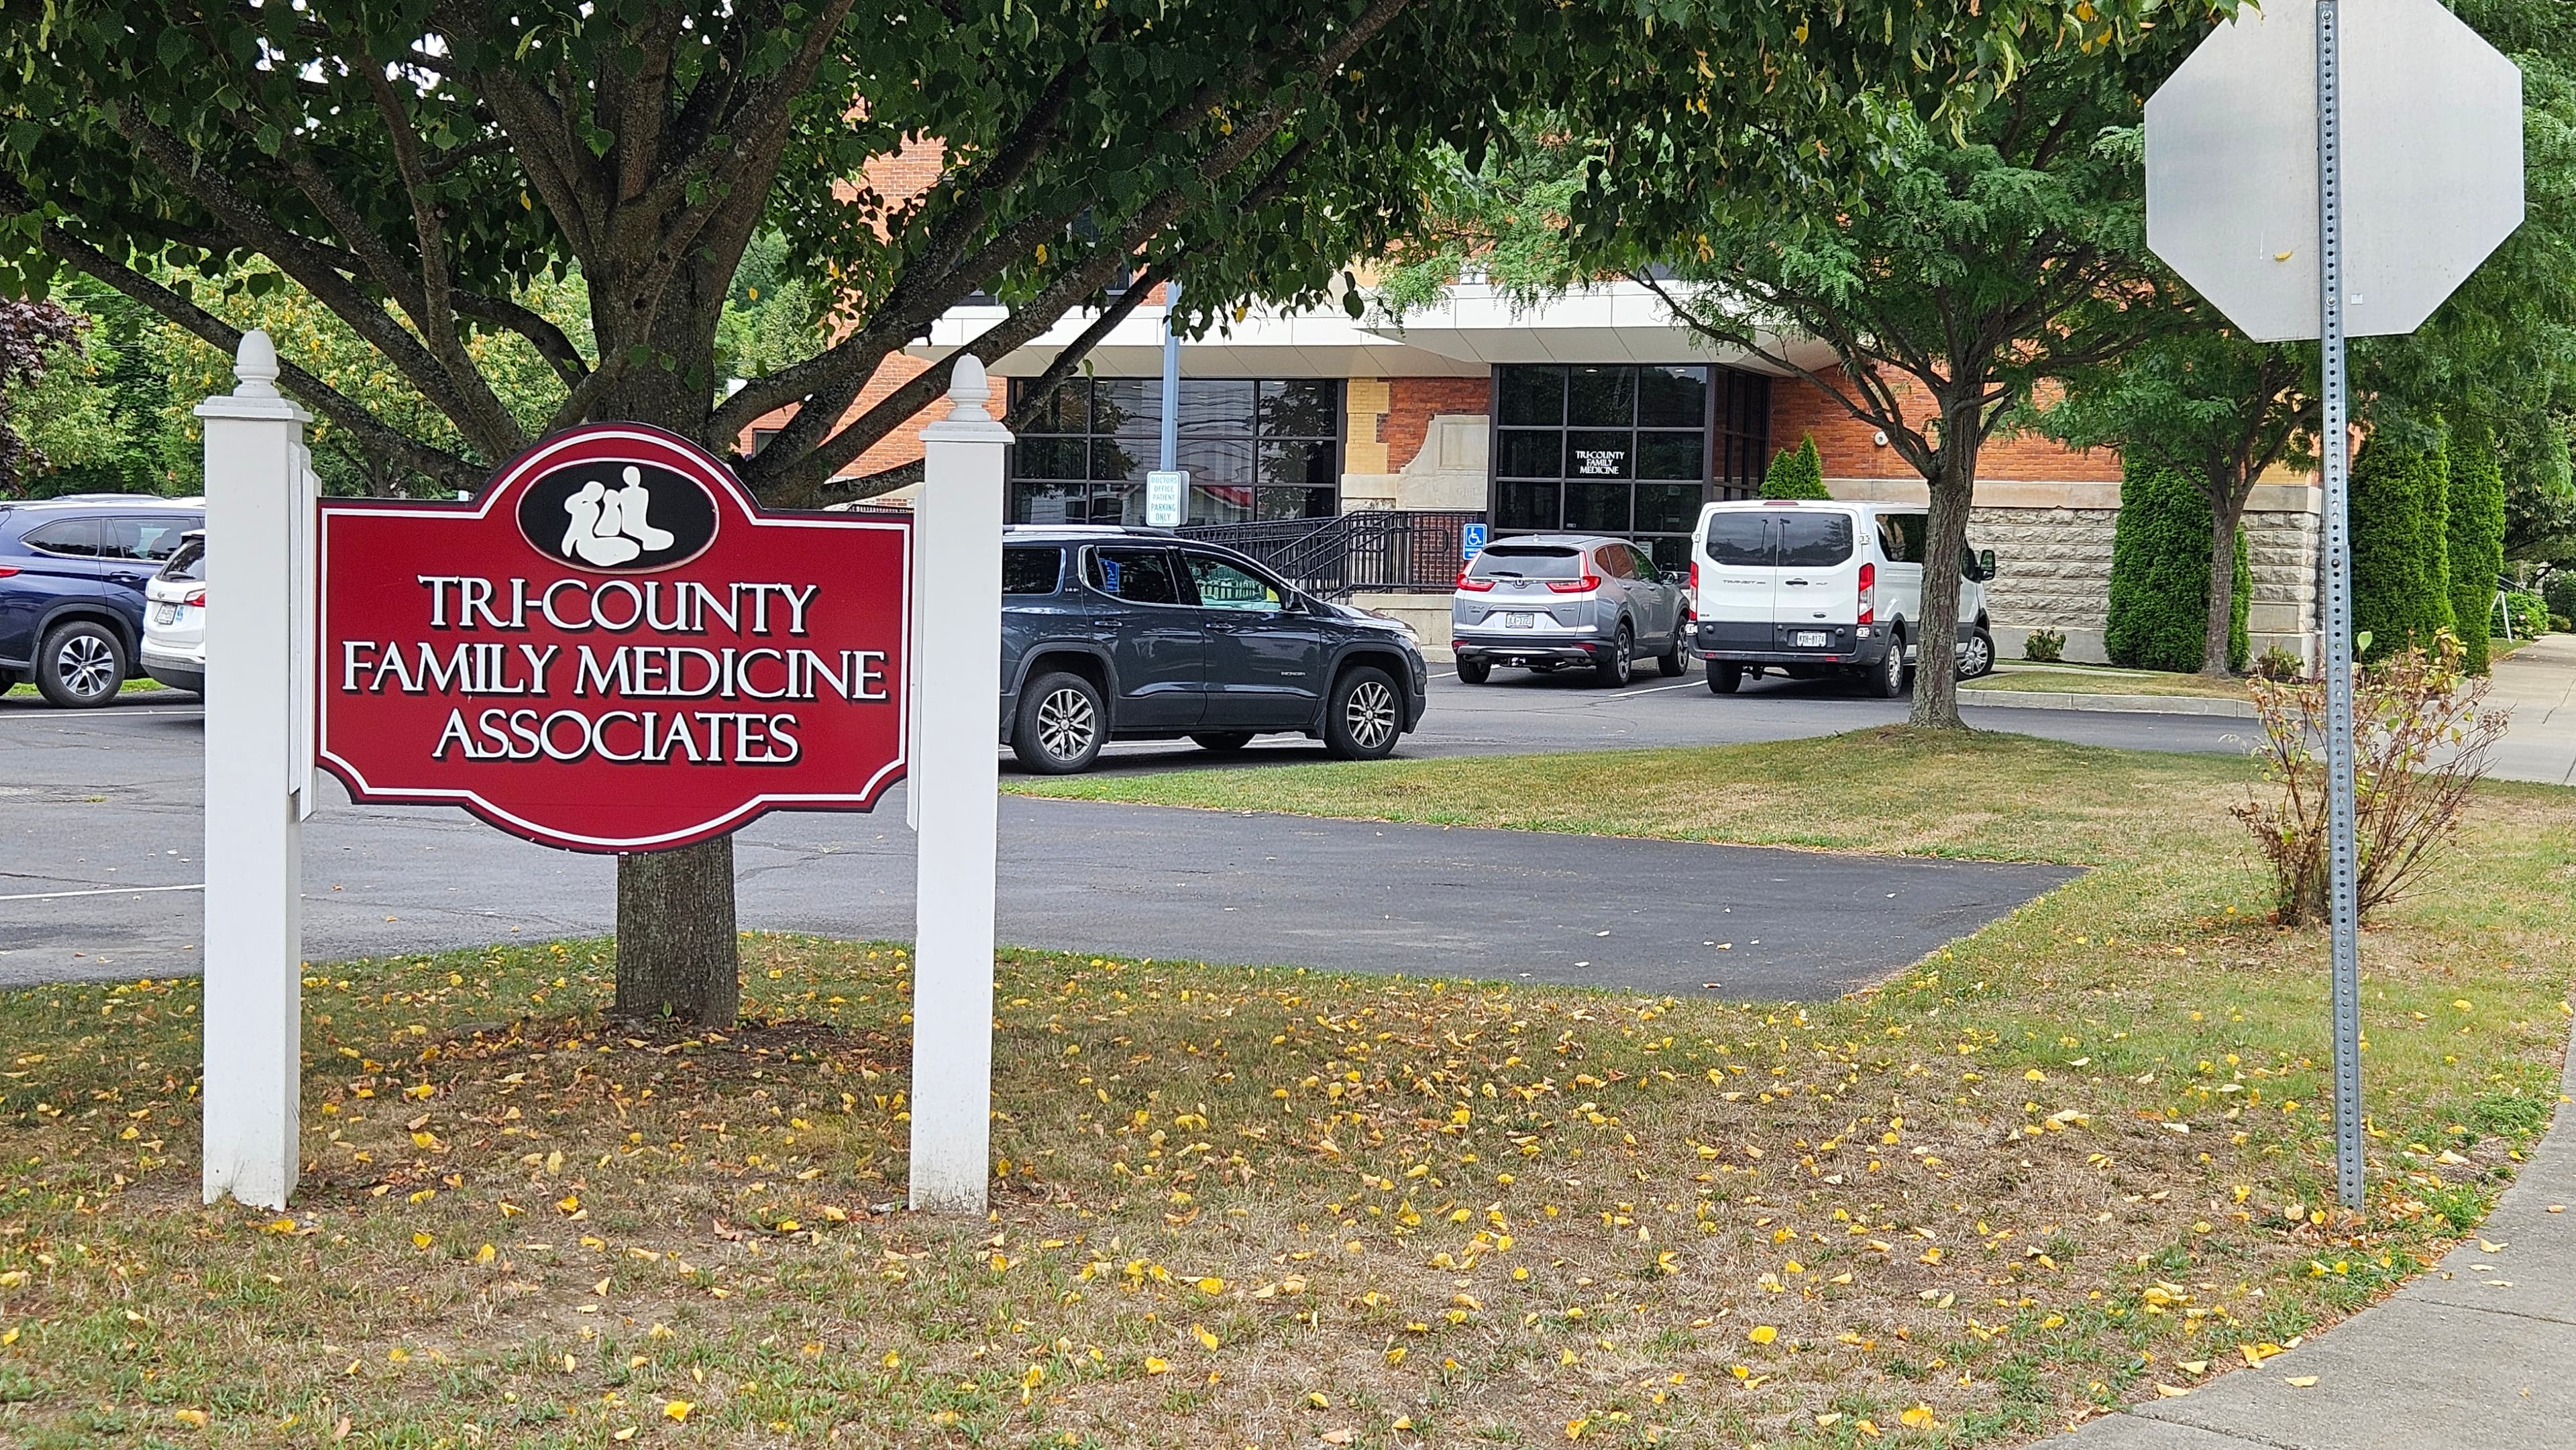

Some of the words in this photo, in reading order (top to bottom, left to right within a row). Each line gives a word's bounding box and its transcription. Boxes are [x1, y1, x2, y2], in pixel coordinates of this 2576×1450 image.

[1575, 450, 1625, 460] TRI-COUNTY
[1587, 458, 1613, 467] FAMILY
[1579, 465, 1619, 475] MEDICINE
[1151, 503, 1176, 512] PARKING
[1155, 512, 1171, 521] ONLY
[417, 574, 818, 634] TRI-COUNTY
[341, 640, 559, 694] FAMILY
[573, 645, 887, 700] MEDICINE
[431, 707, 799, 763] ASSOCIATES
